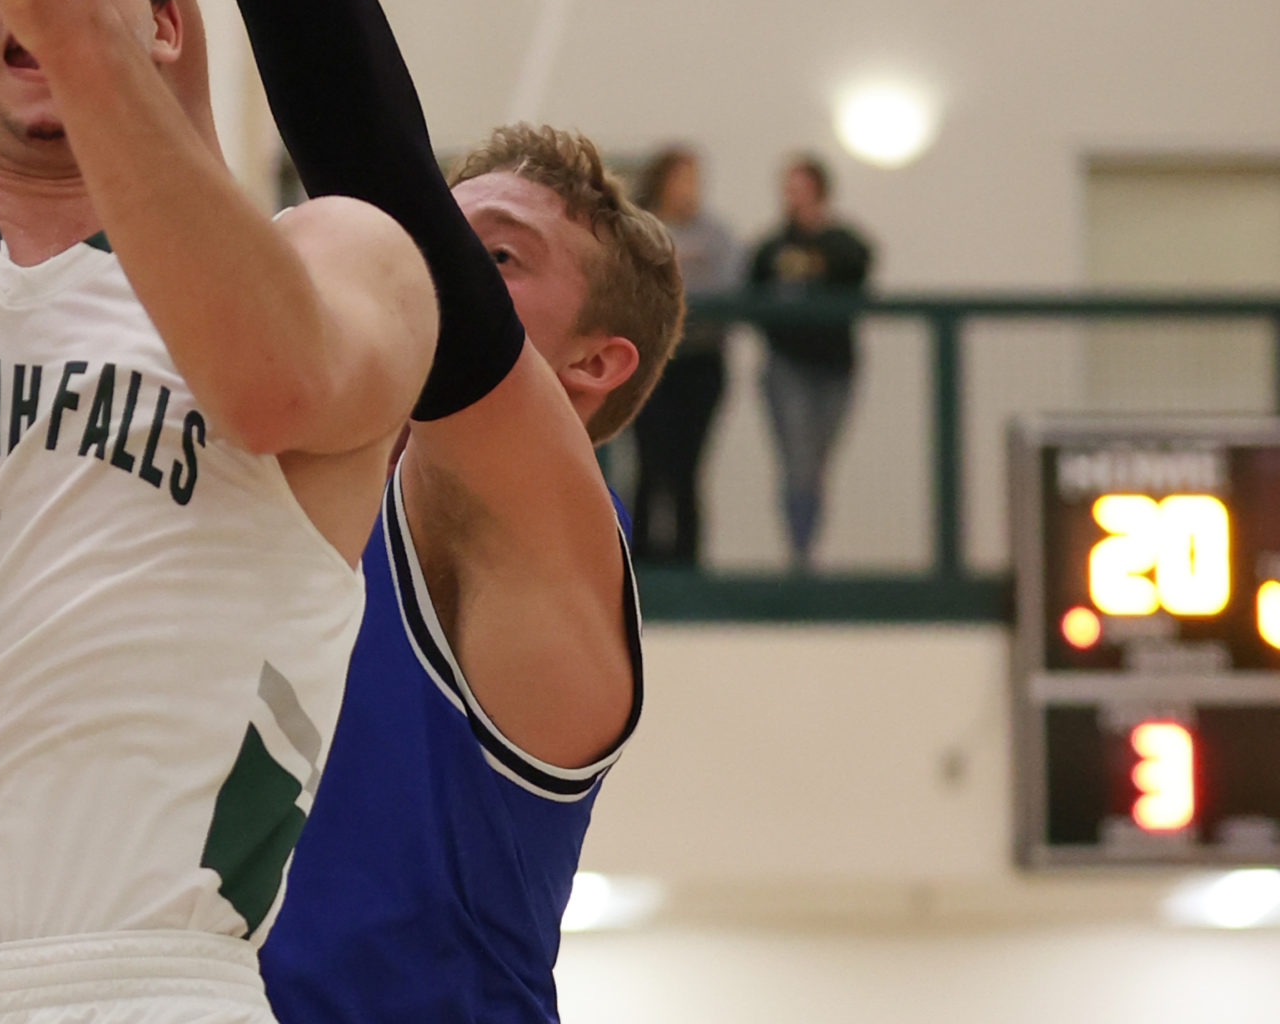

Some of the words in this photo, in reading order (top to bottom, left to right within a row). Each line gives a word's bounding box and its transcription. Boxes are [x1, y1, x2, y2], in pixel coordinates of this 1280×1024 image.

[45, 360, 207, 507] FALLS
[1088, 493, 1231, 617] 20
[1130, 721, 1196, 833] 3
